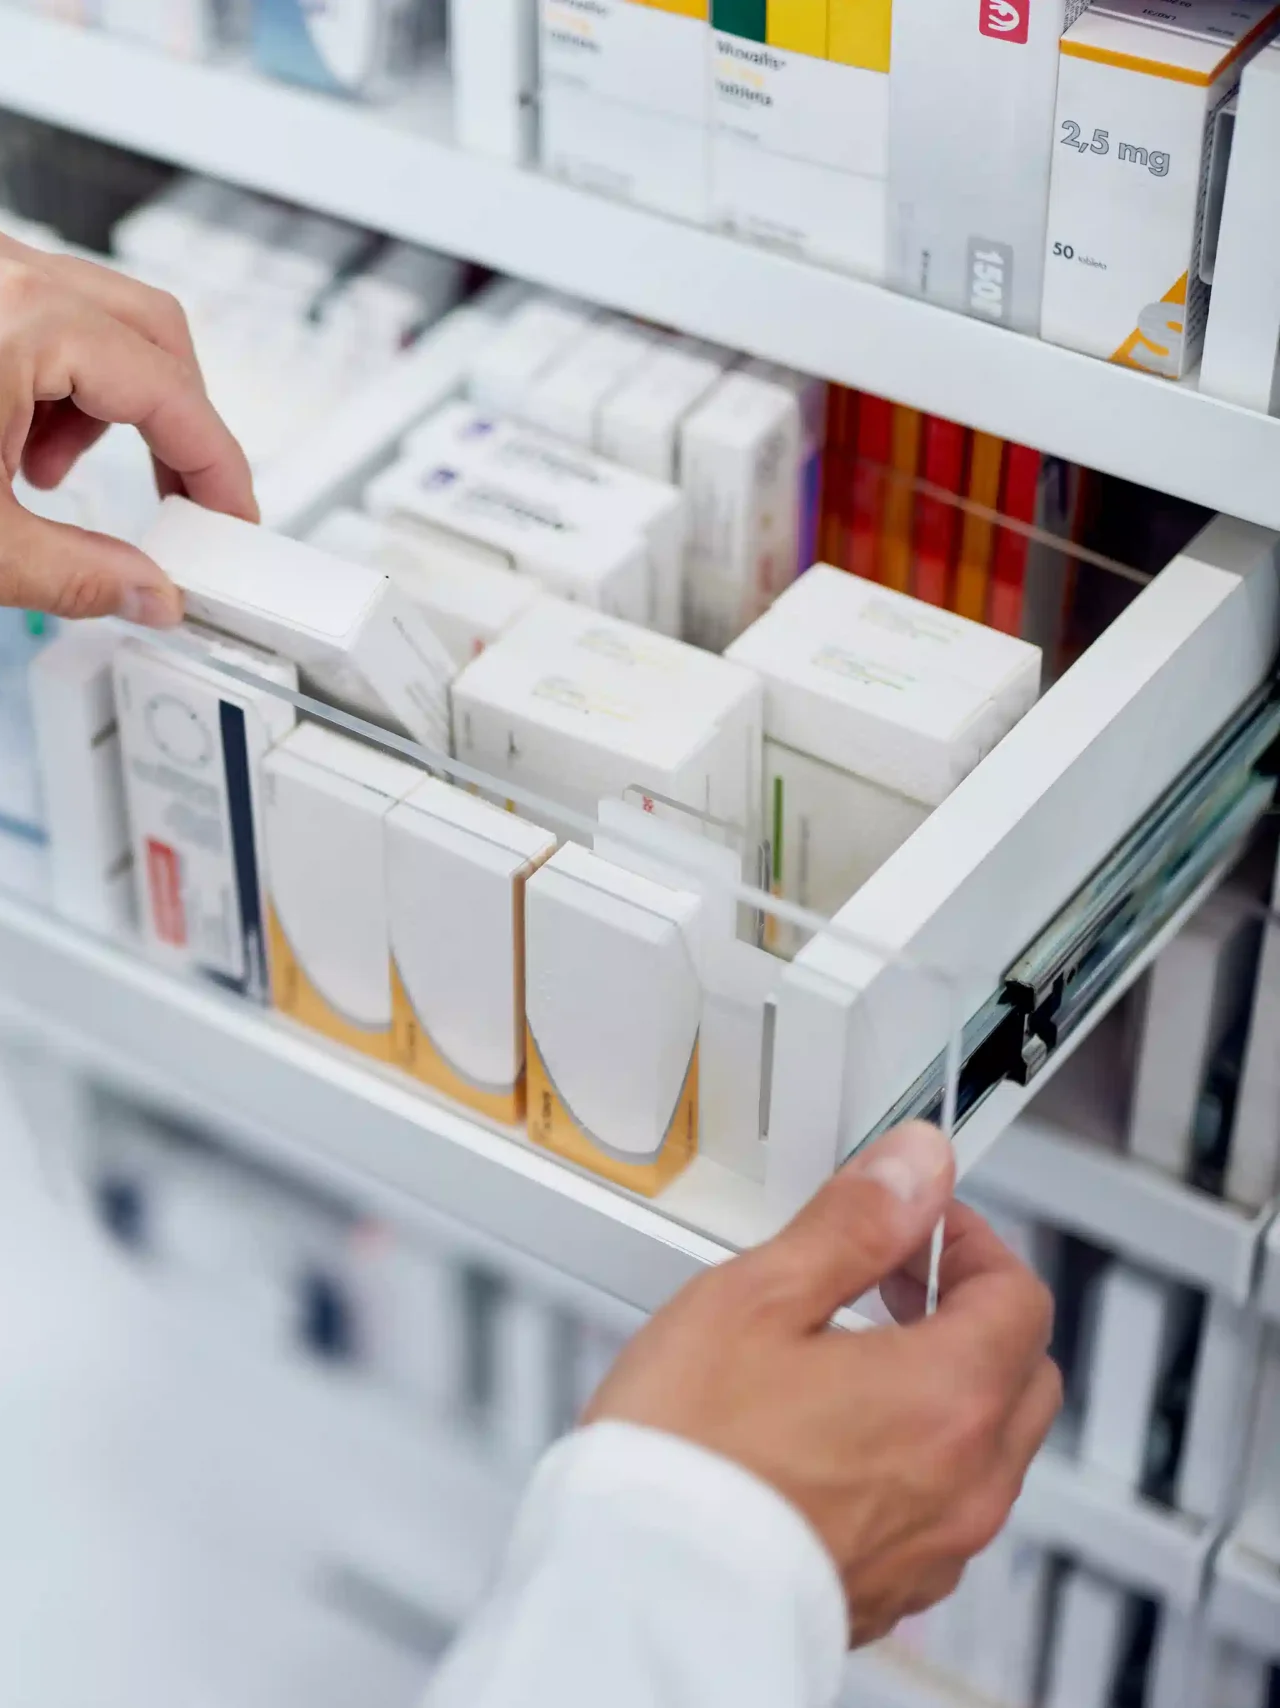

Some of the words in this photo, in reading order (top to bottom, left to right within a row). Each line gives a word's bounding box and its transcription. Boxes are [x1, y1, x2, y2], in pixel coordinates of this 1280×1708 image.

[1060, 119, 1110, 155] 2,5
[1118, 141, 1171, 177] mg
[1052, 241, 1074, 260] 50
